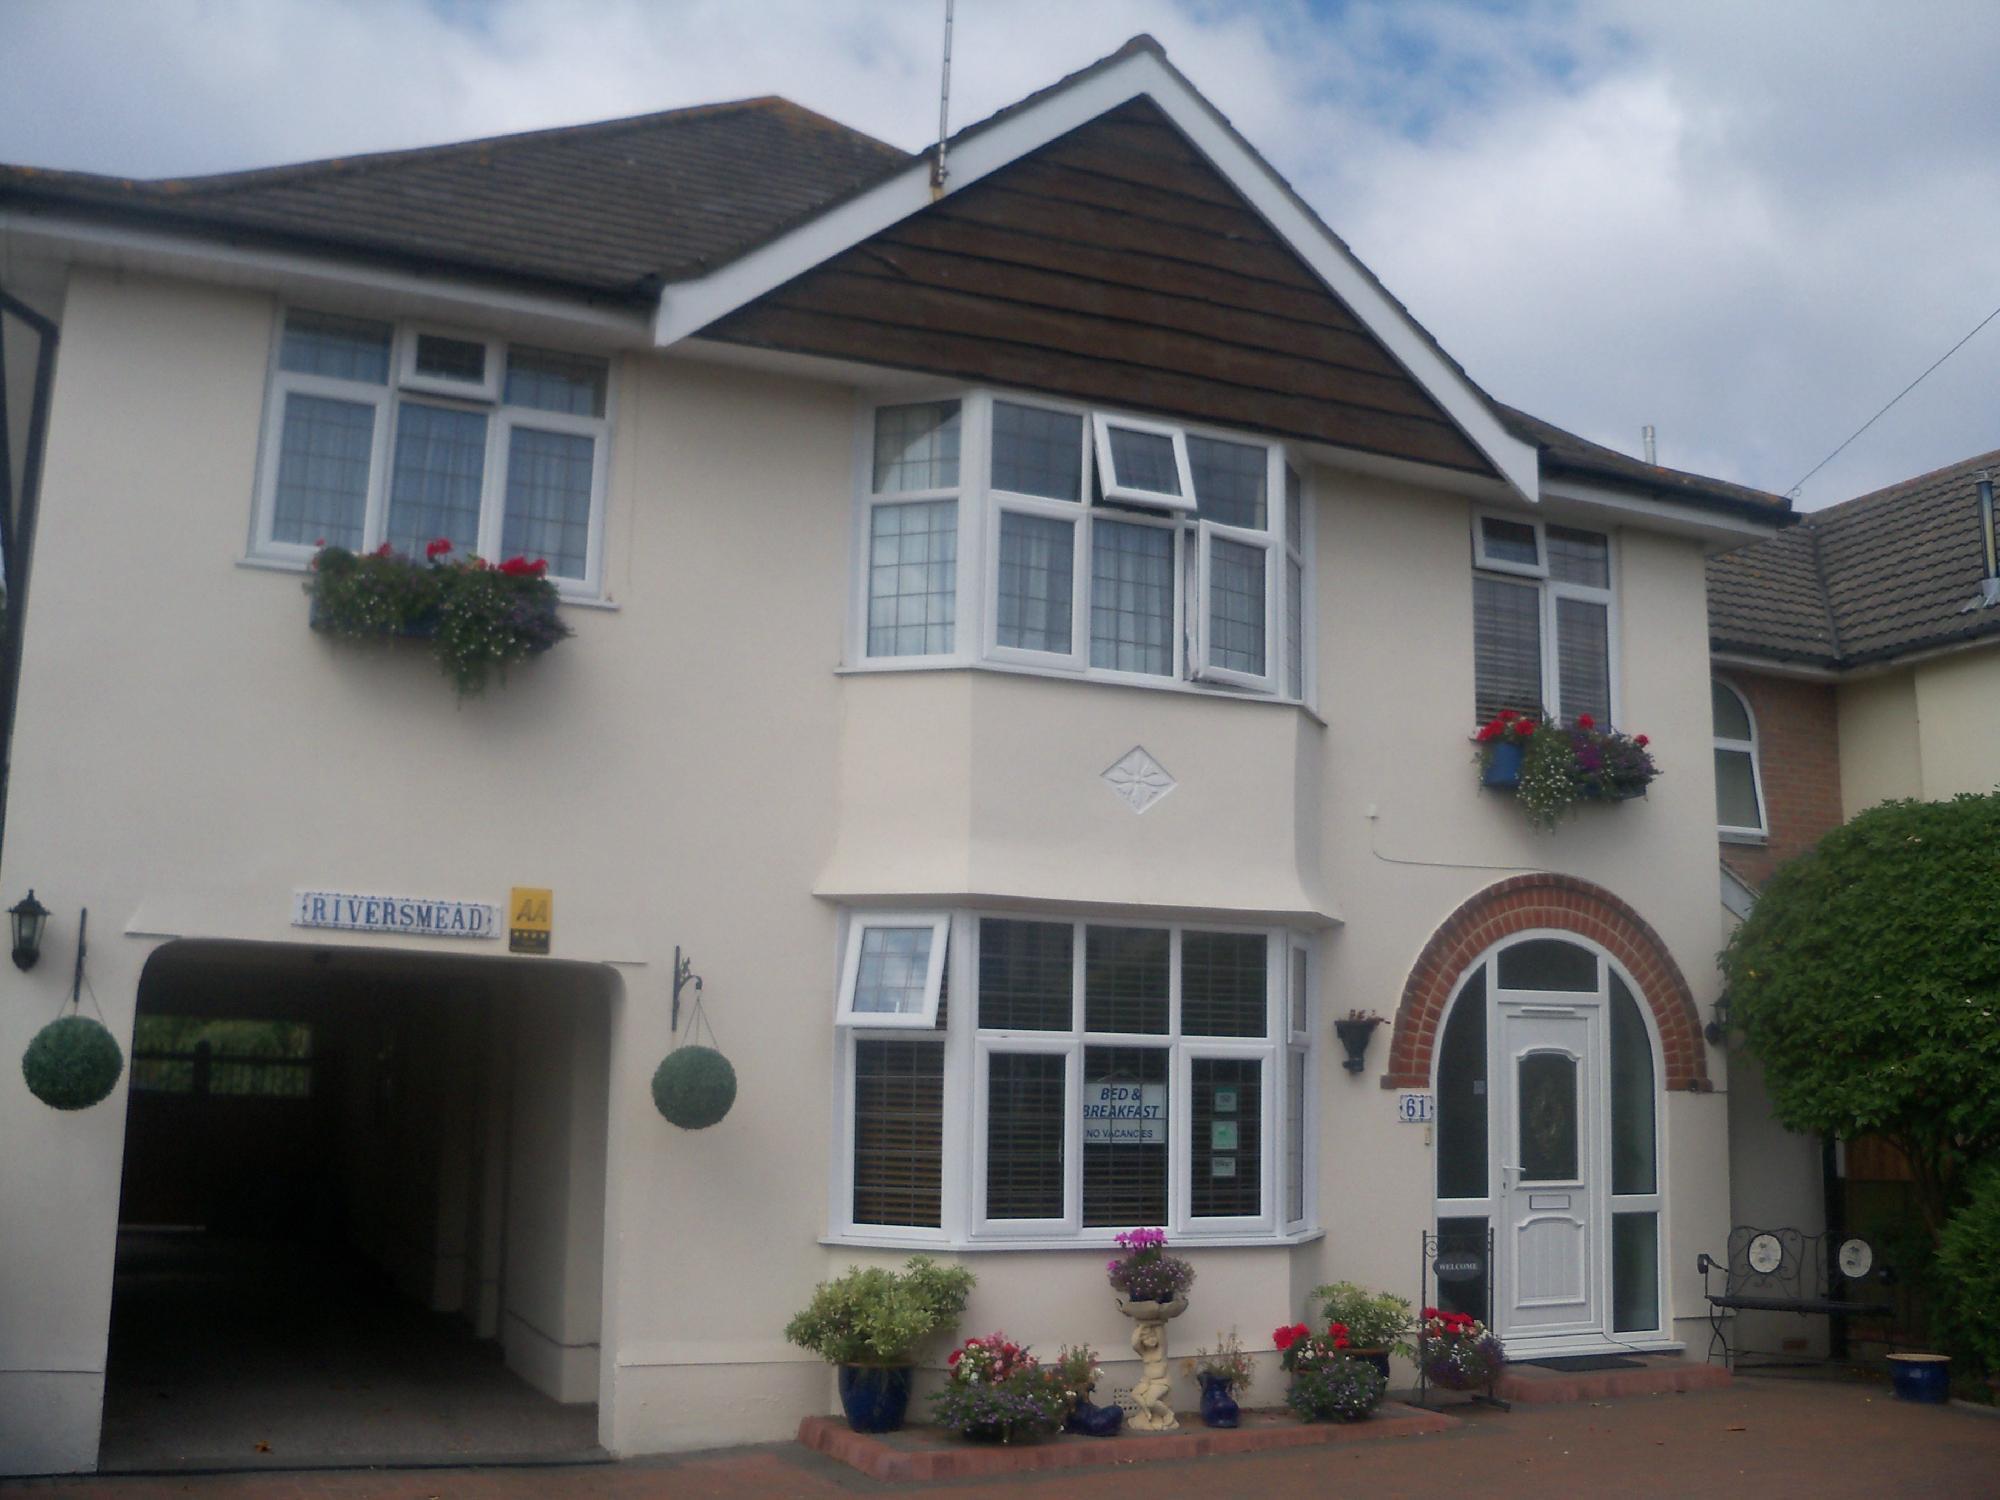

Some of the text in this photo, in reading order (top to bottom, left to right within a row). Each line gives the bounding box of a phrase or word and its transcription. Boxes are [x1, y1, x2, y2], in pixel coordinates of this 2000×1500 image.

[312, 896, 484, 933] RIVERSMEAD
[516, 898, 548, 923] AA
[1100, 1087, 1142, 1101] BED &
[1083, 1104, 1160, 1119] BREAKFAST
[1406, 1098, 1425, 1118] 61
[1086, 1129, 1153, 1138] NO VACANCES
[1439, 1262, 1478, 1271] WELCOME
